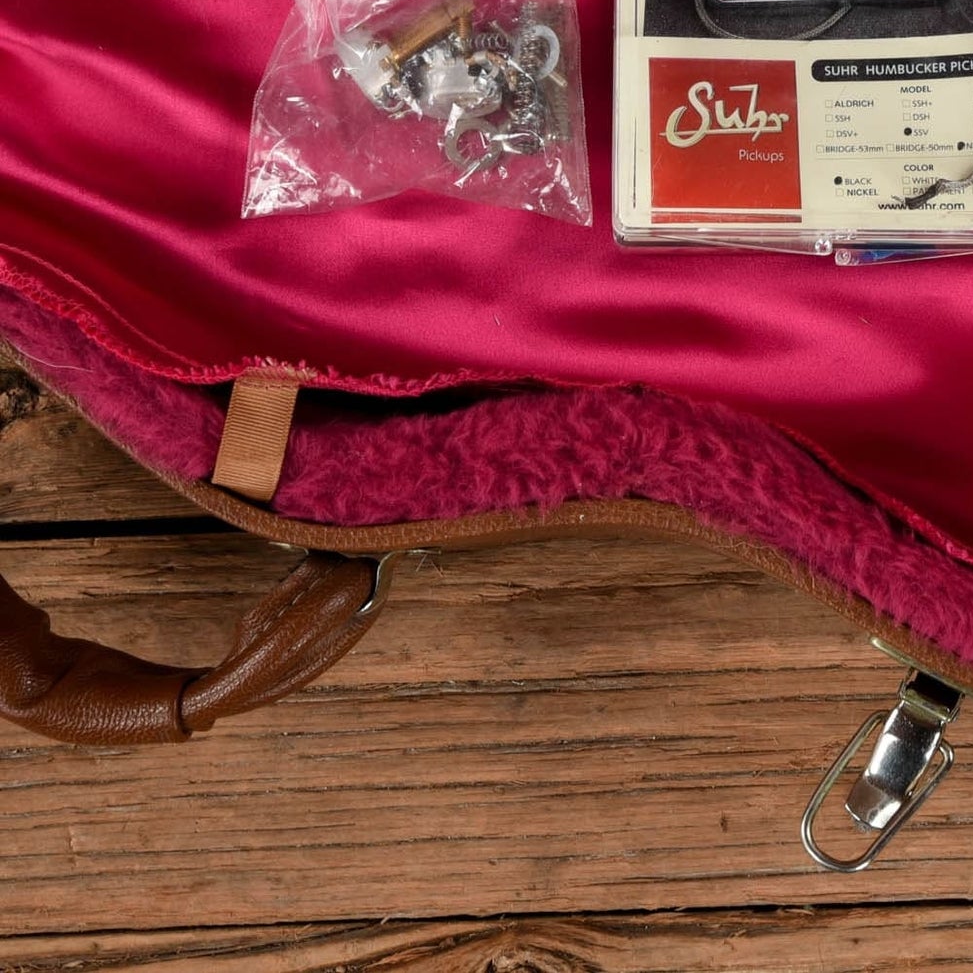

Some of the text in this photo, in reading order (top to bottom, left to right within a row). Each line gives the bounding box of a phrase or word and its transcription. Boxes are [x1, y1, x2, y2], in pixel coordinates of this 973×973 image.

[824, 65, 858, 76] SUHR
[866, 62, 946, 75] HUMBUCKER
[900, 85, 931, 94] MODEL
[835, 99, 874, 108] ALDRICH
[912, 99, 932, 108] SSH+
[659, 81, 789, 148] Suhr
[835, 114, 850, 122] SSH
[912, 113, 930, 121] DSH
[836, 129, 858, 138] DSV+
[913, 128, 929, 137] SSV
[826, 144, 884, 153] BRIDGE-53mm
[895, 143, 954, 152] BRIDGE-50mm
[739, 149, 784, 163] Pickups
[904, 164, 934, 172] COLOR
[845, 177, 872, 185] BLACK
[847, 188, 879, 197] NICKEL
